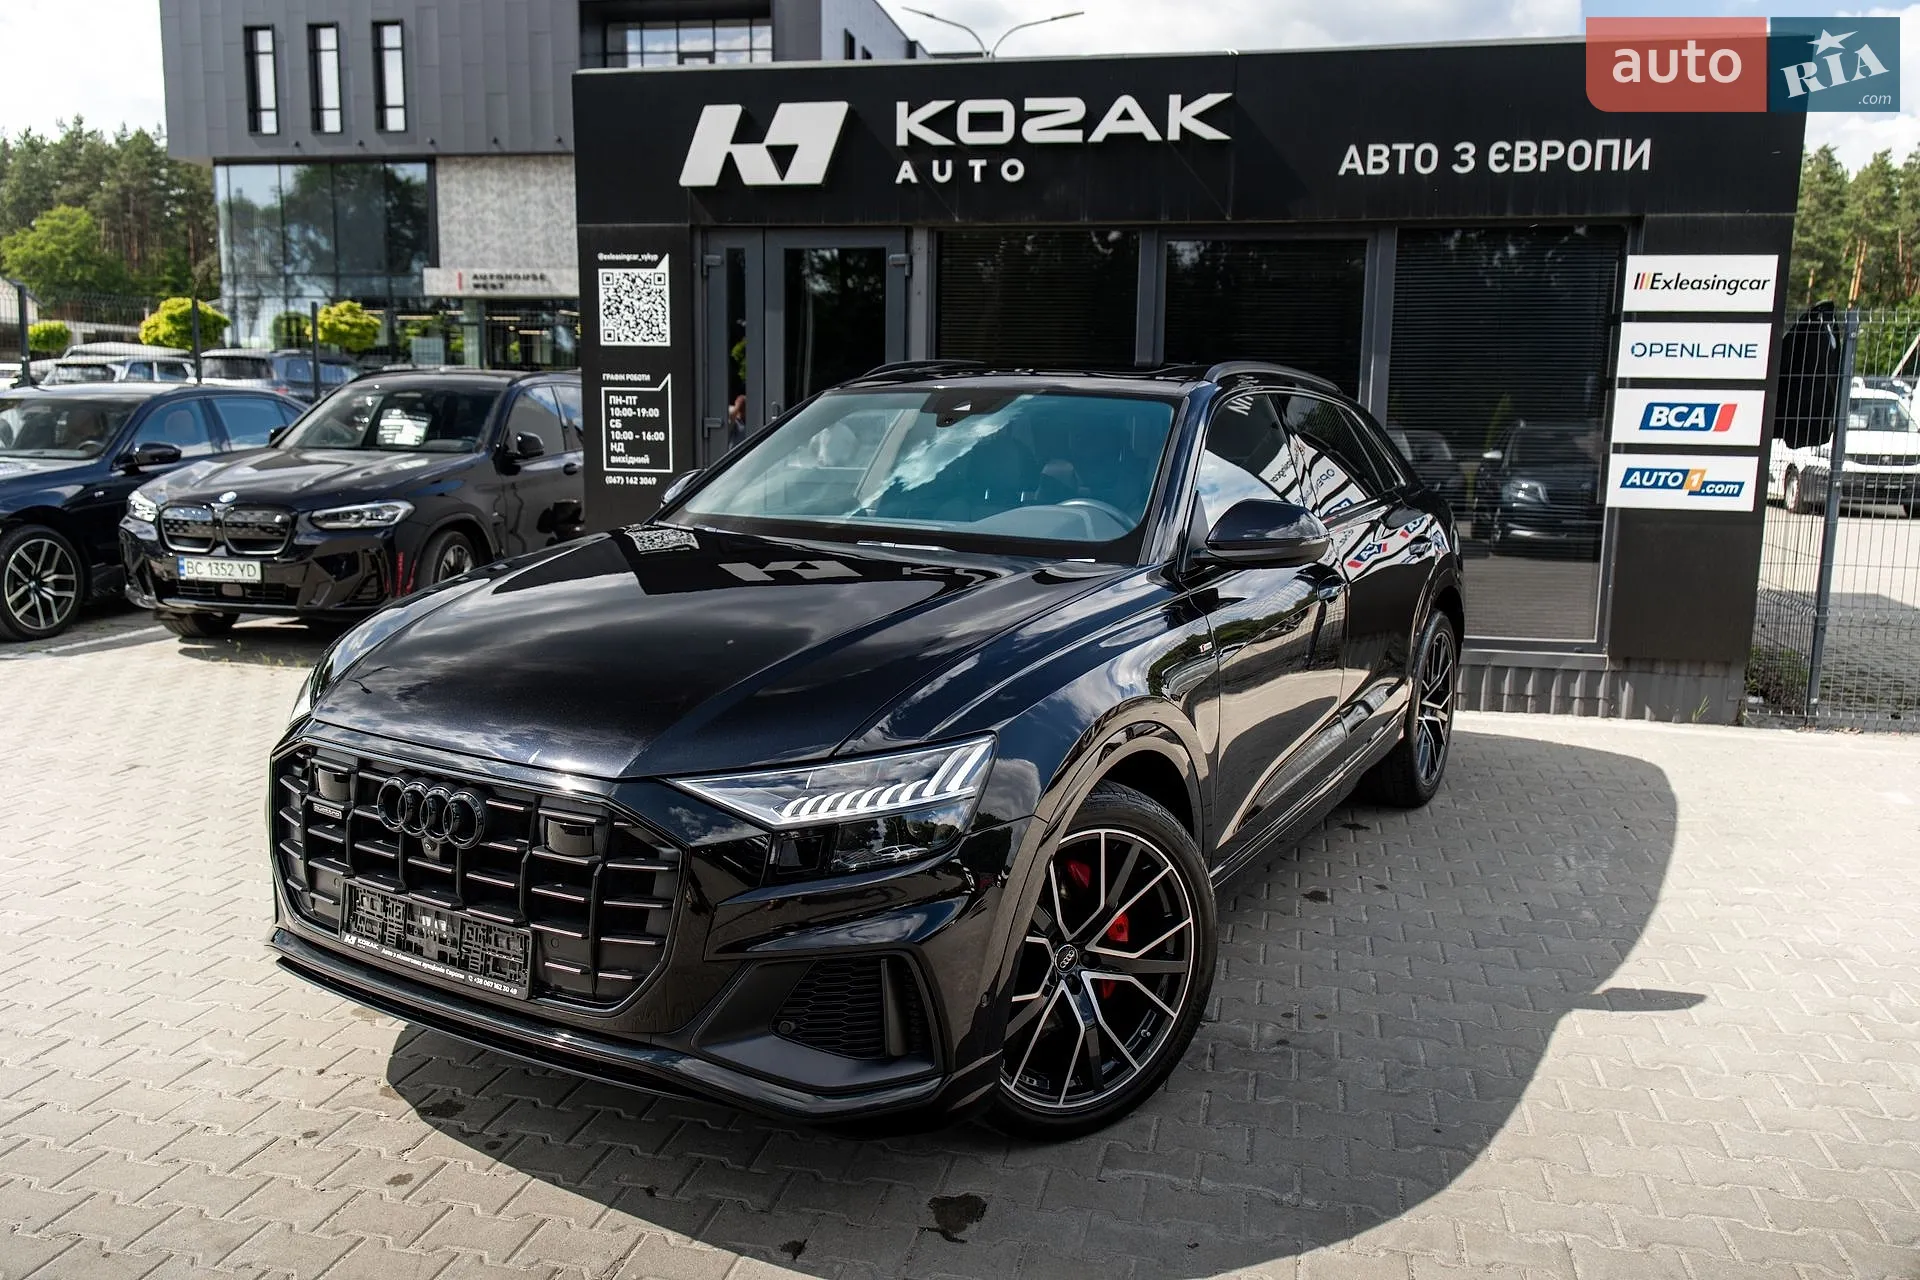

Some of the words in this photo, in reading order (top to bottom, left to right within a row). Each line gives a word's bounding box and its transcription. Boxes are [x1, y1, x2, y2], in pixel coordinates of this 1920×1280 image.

[896, 92, 1233, 147] KOZAK
[1338, 142, 1439, 176] АВТО
[1452, 144, 1476, 174] З
[1487, 138, 1652, 174] ЄВРОПИ
[895, 158, 1026, 184] AUTO
[1649, 272, 1770, 296] Exleasingcar
[1631, 342, 1758, 358] OPENLANE
[608, 395, 638, 406] ПН-ПТ
[609, 407, 660, 418] 10:00-19:00
[1649, 406, 1706, 428] BCA
[609, 419, 622, 429] СБ
[610, 430, 634, 441] 10:00
[641, 431, 665, 442] 16:00
[610, 441, 625, 454] НД
[610, 453, 650, 465] вихідний
[605, 475, 625, 486] (067)
[625, 476, 639, 486] 162
[639, 476, 657, 486] 3049
[186, 560, 203, 575] BC
[208, 561, 235, 577] 1352
[238, 562, 257, 577] YD
